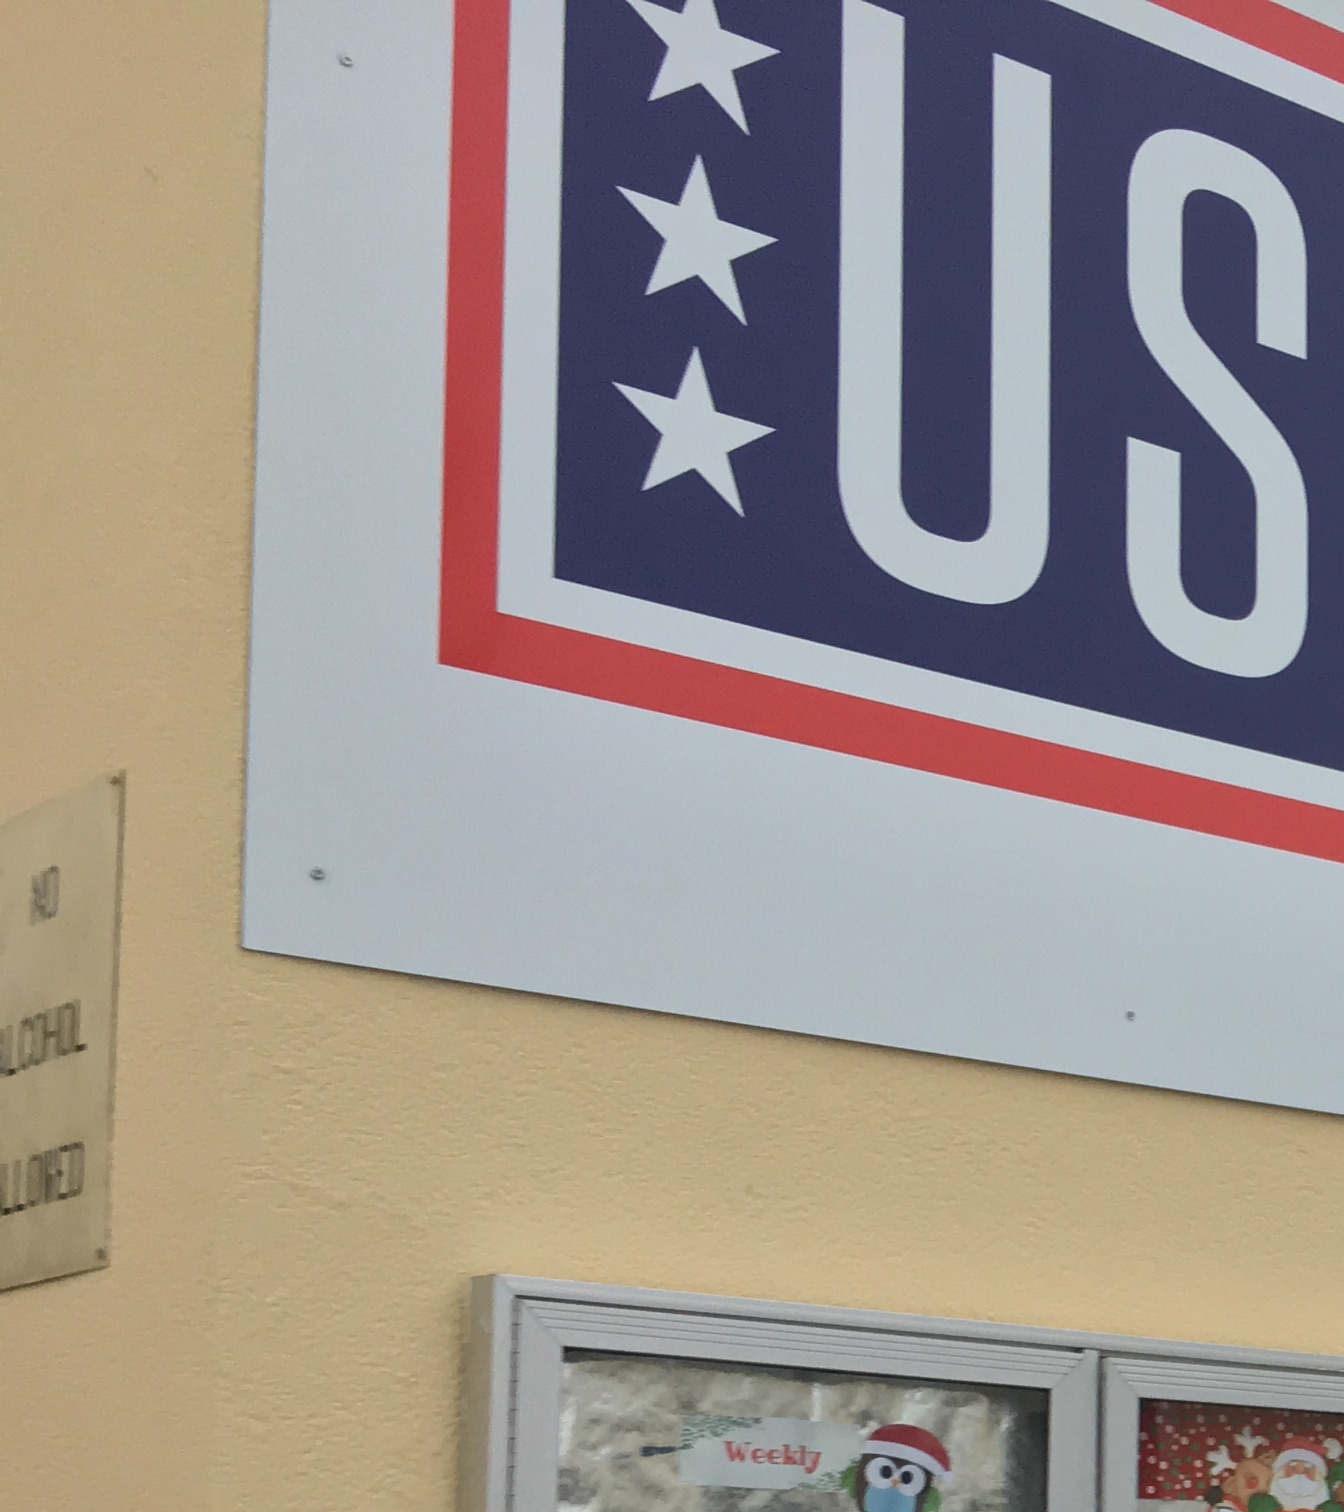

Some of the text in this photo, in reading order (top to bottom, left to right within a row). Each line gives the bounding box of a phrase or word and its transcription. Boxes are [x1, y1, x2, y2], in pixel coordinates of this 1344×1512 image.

[30, 866, 60, 925] NO
[0, 1141, 85, 1215] LLOWED
[723, 1441, 822, 1474] Weekly
